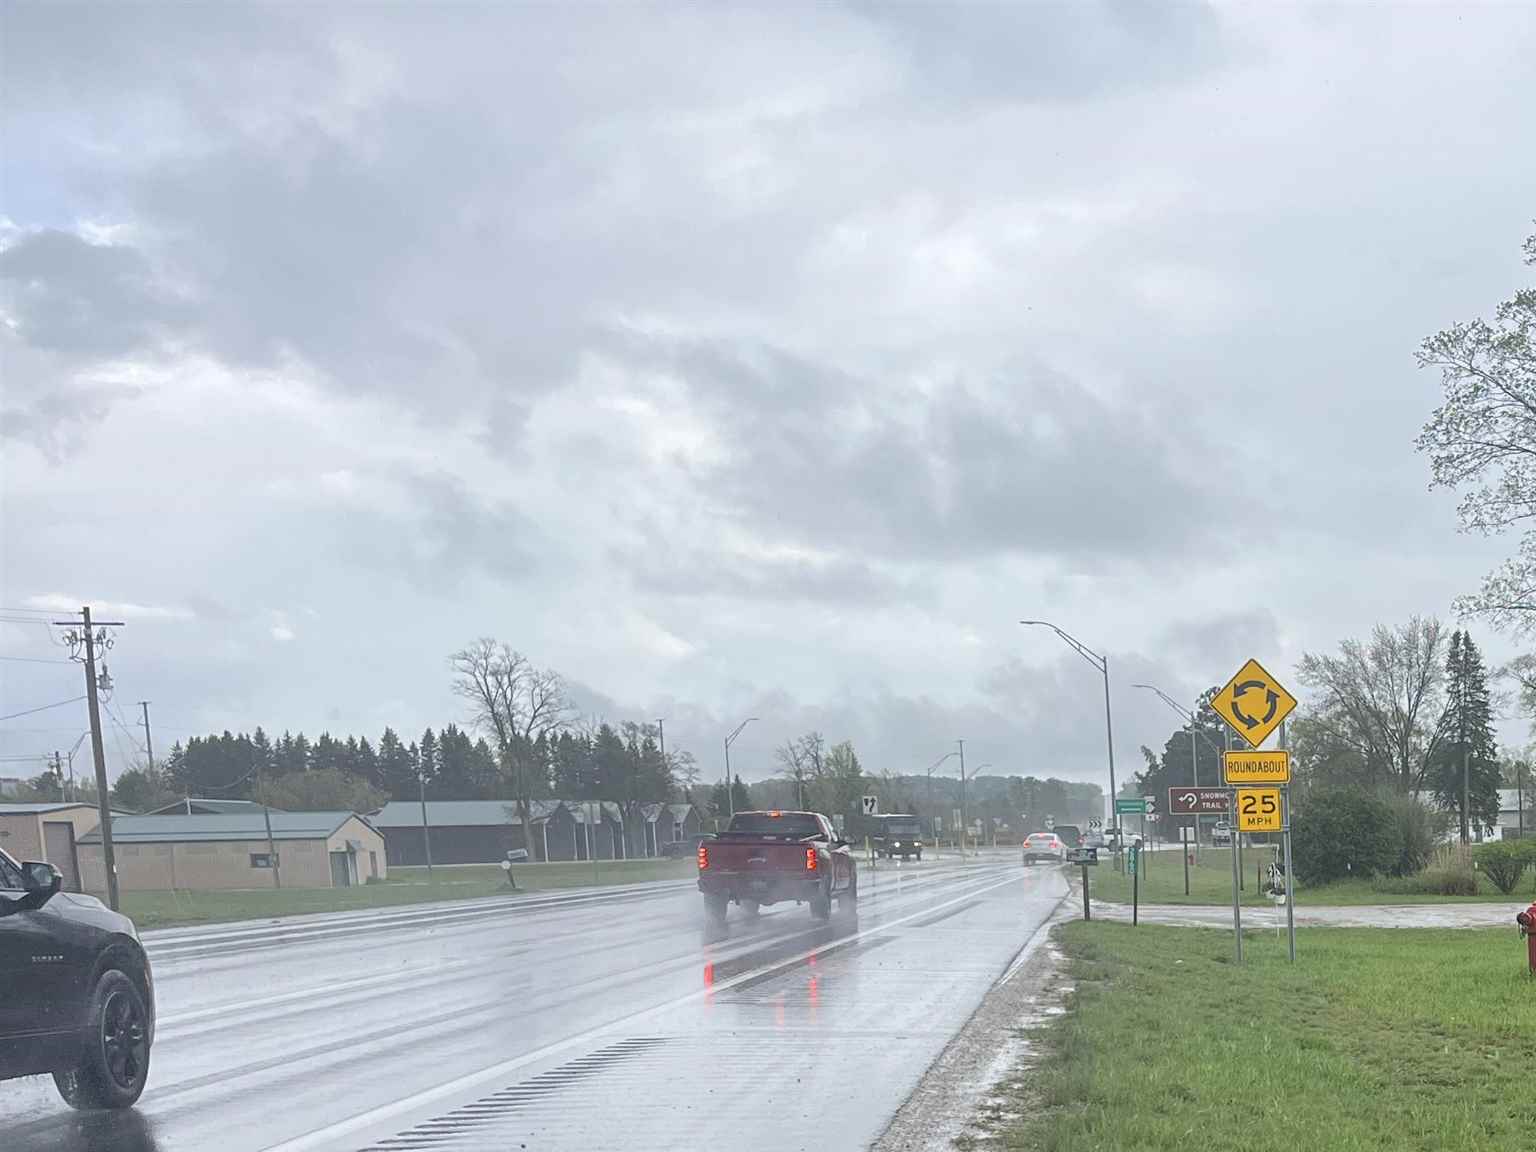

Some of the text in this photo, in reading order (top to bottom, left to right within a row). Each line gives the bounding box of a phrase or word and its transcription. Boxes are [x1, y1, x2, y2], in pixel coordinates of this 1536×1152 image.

[1228, 760, 1285, 774] ROUNDABOUT
[1242, 795, 1276, 814] 25
[1247, 816, 1272, 825] MPH
